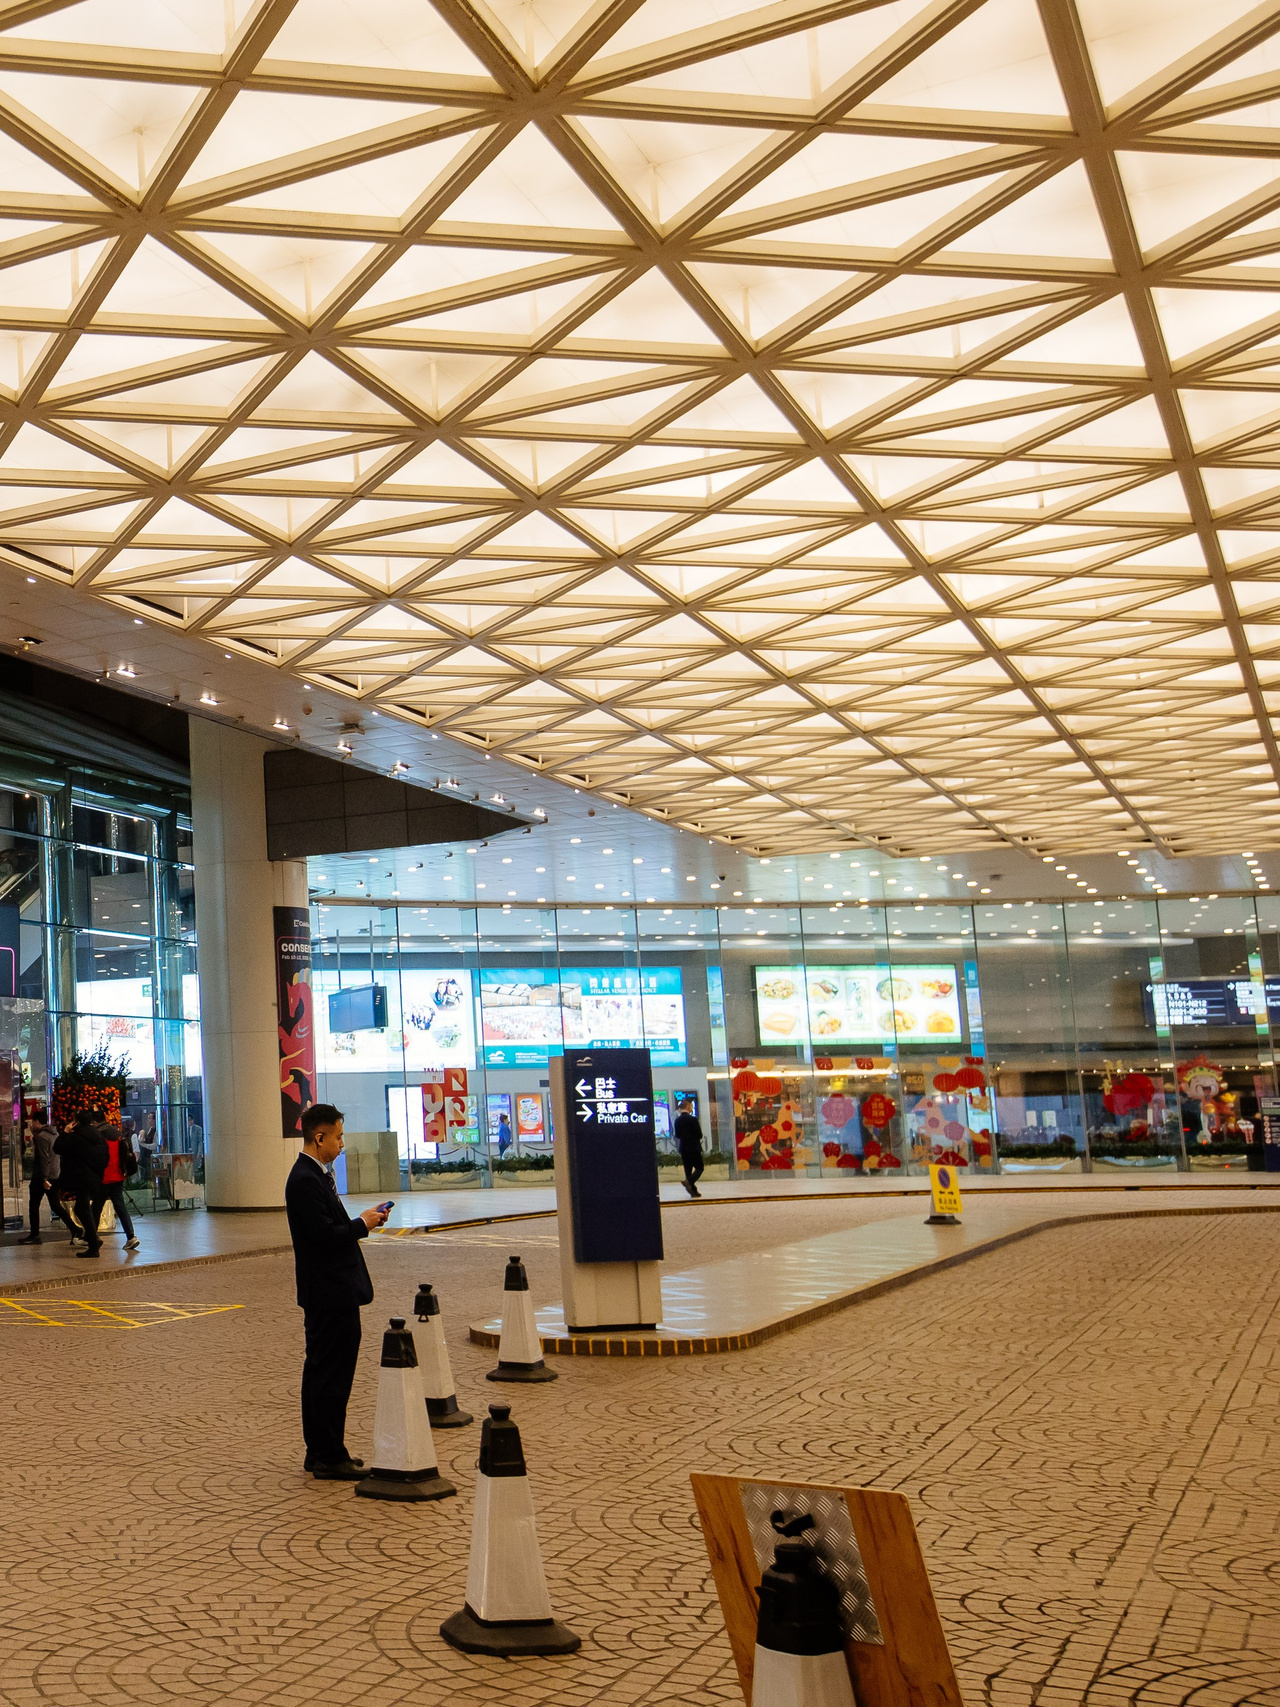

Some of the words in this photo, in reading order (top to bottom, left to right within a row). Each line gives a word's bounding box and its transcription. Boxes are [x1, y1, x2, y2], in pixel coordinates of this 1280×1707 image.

[595, 1077, 617, 1089] 巴士
[595, 1089, 615, 1098] Bus
[596, 1102, 629, 1114] 私家車
[597, 1113, 629, 1123] Private
[630, 1112, 648, 1123] Car
